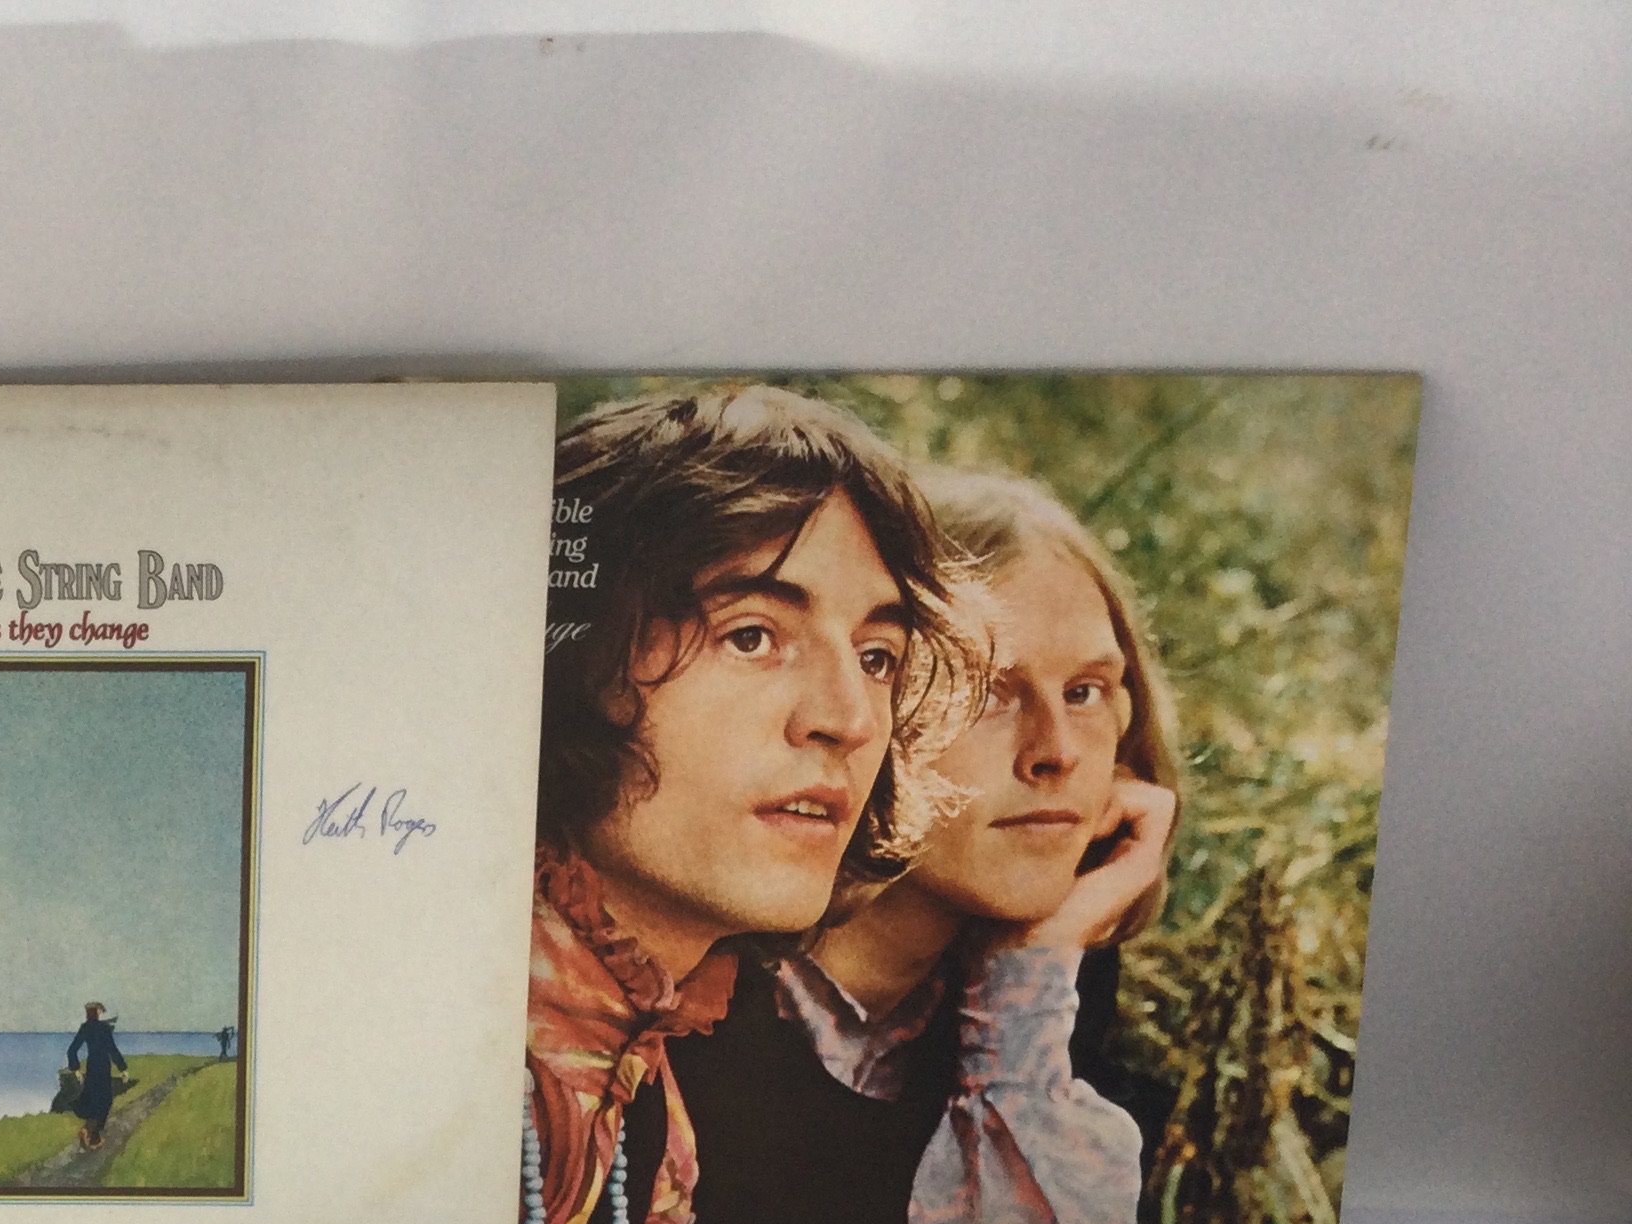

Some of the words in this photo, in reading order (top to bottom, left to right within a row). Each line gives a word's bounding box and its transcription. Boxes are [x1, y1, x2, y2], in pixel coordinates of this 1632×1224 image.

[16, 549, 122, 611] STRING
[136, 549, 224, 610] BAND
[8, 610, 63, 648] they
[69, 611, 150, 649] change
